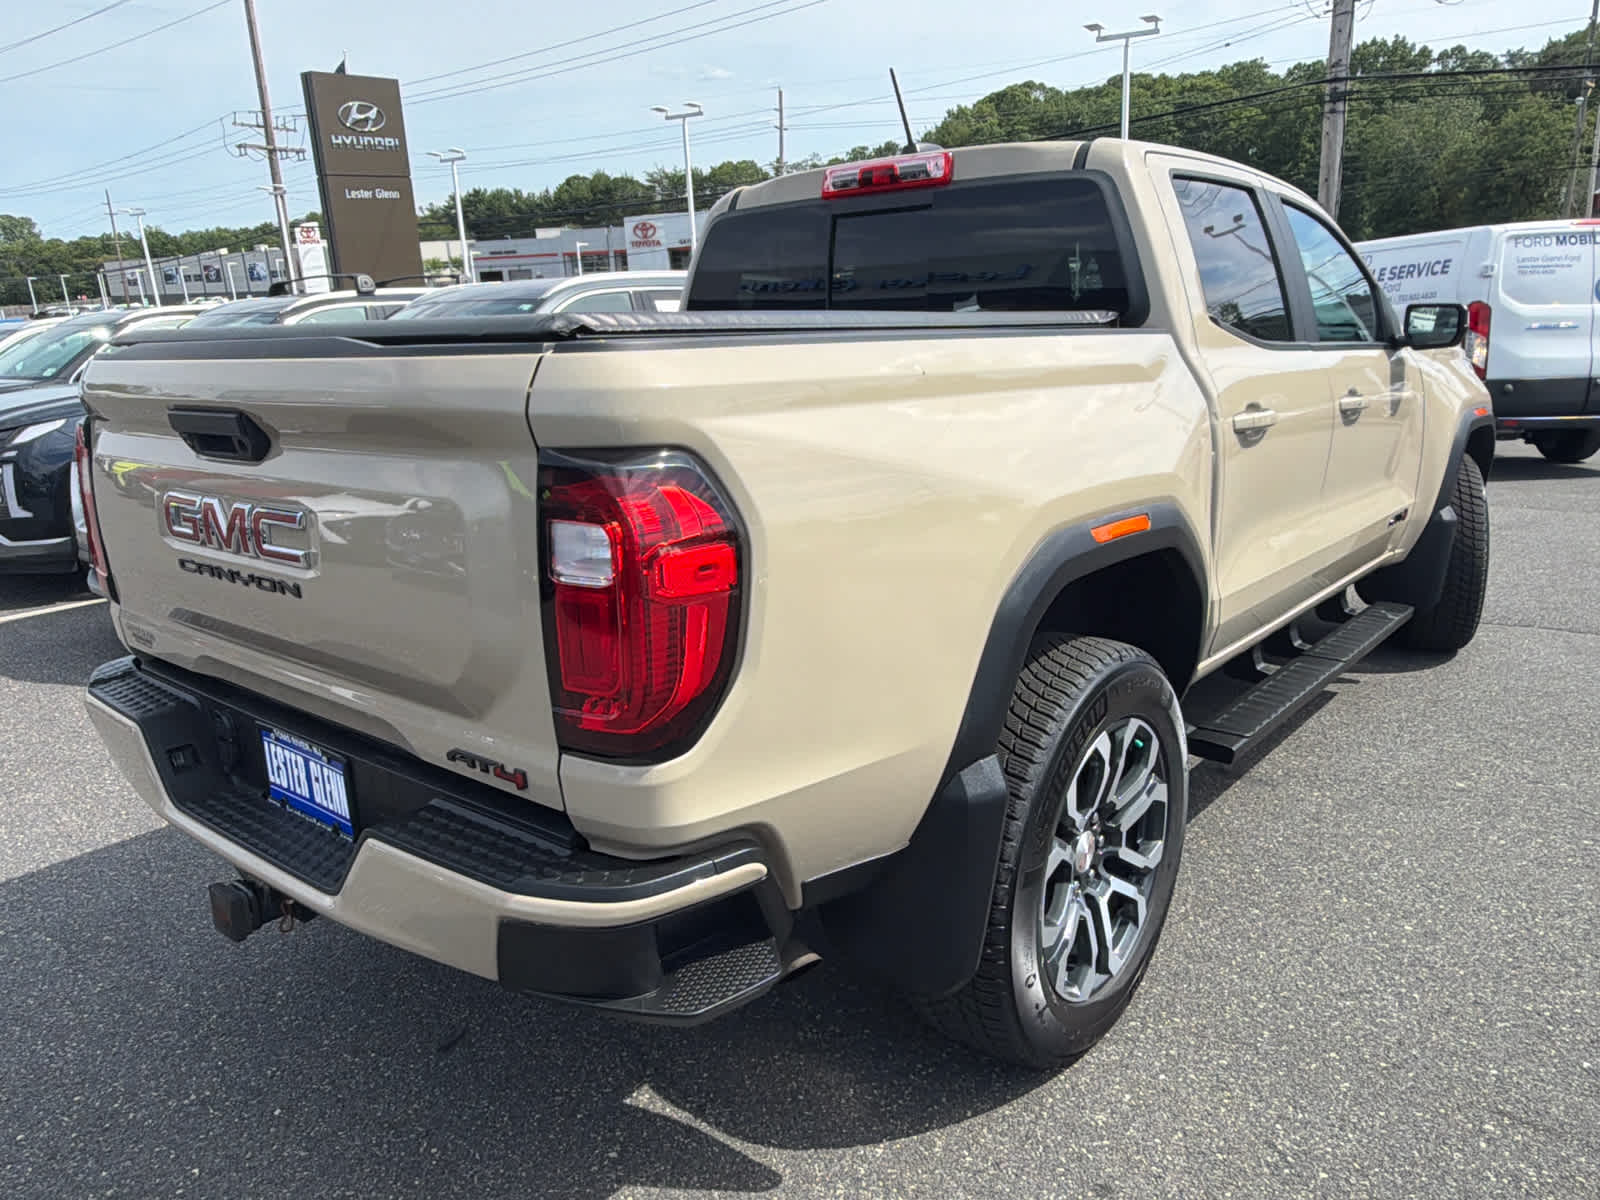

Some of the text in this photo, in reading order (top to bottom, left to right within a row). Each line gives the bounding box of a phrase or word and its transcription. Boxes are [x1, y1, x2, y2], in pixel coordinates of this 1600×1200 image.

[330, 134, 400, 151] HYUNDAI
[345, 188, 401, 199] Lester Glenn
[632, 239, 662, 249] TOYOTA
[1514, 235, 1553, 248] FORD
[1387, 258, 1453, 281] SERVICE
[1383, 281, 1402, 293] Ford
[163, 490, 312, 570] GMC
[177, 558, 303, 599] CANYON
[446, 746, 529, 790] AT4
[262, 740, 310, 800] LESTER
[309, 760, 351, 821] GLENN
